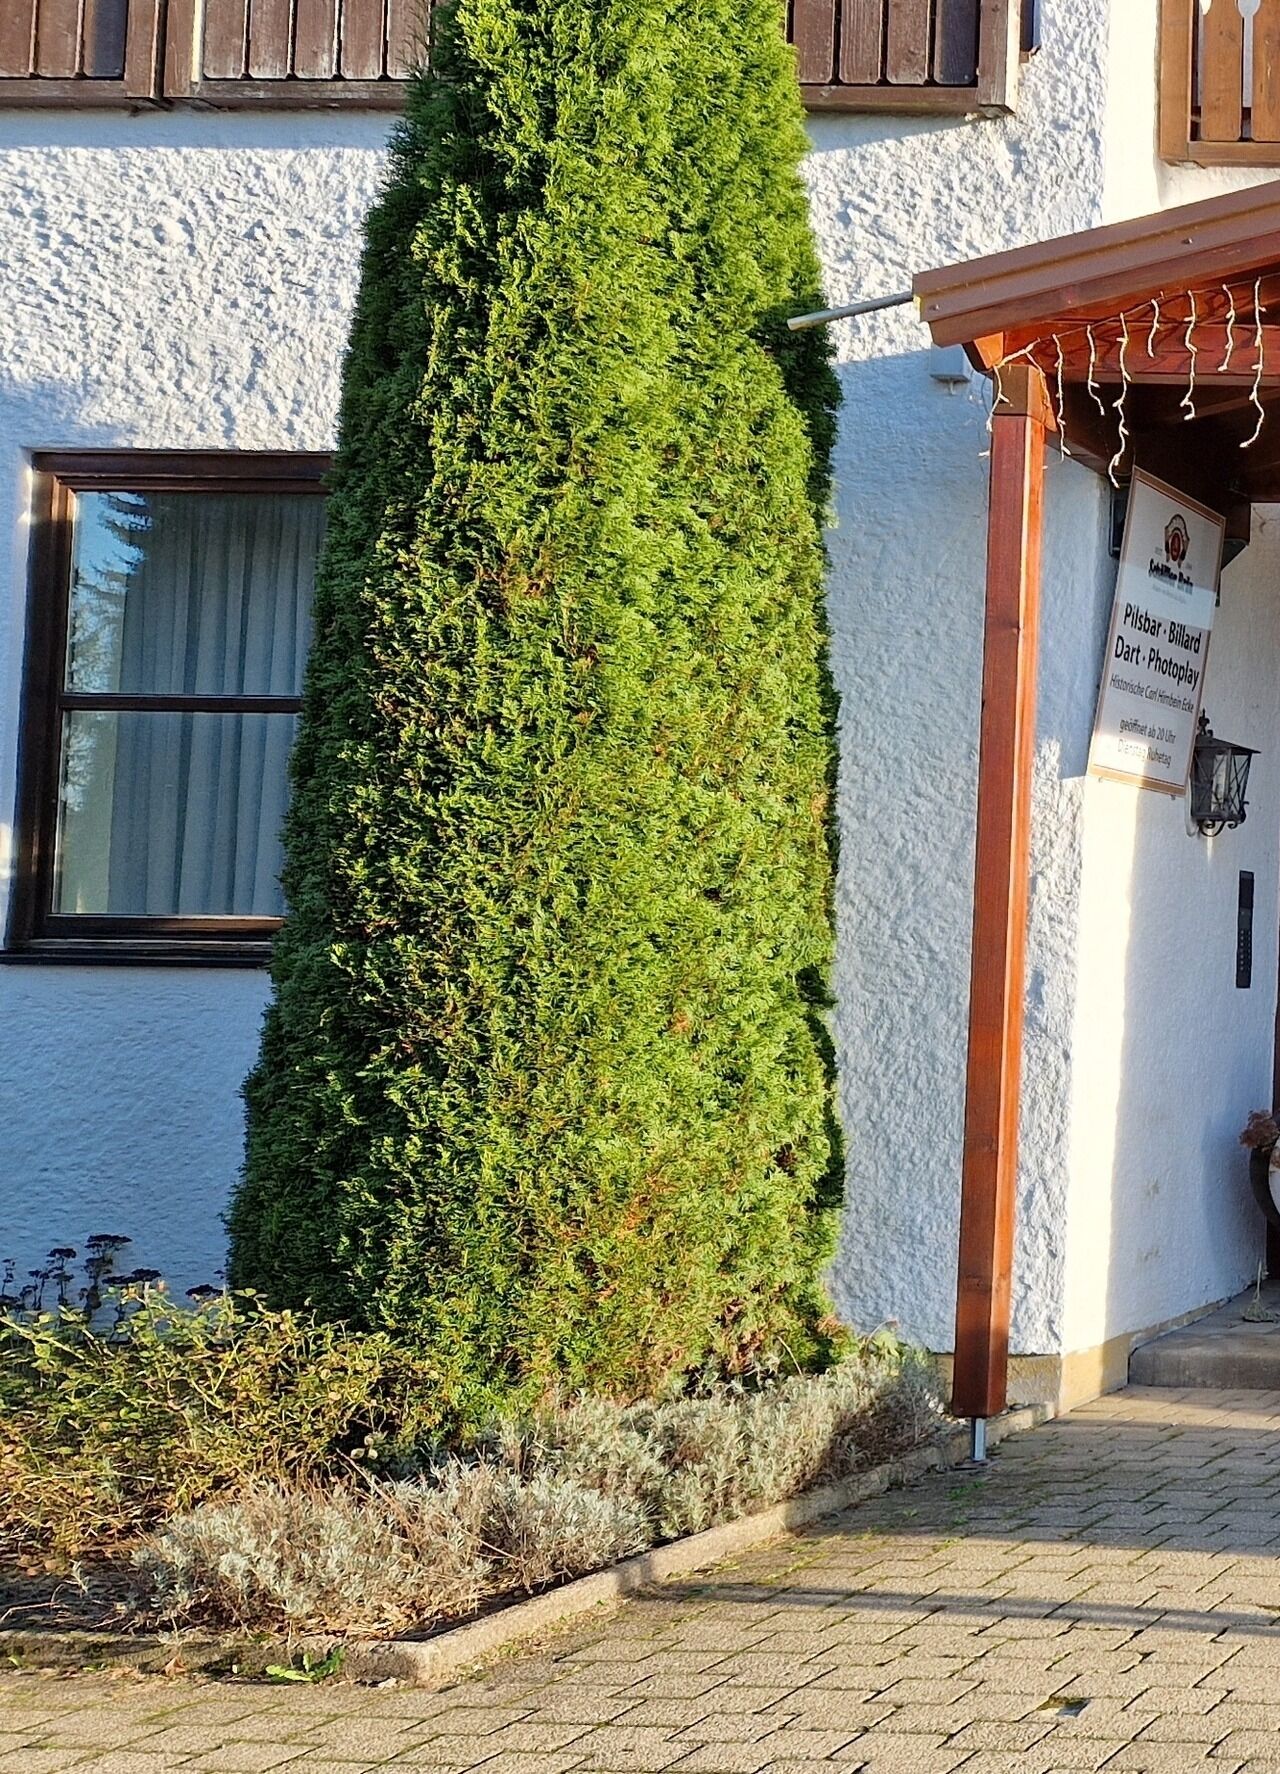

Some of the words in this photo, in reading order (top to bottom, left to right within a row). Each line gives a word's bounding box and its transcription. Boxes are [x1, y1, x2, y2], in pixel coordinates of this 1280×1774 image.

[1123, 602, 1162, 638] Pilsbar
[1168, 620, 1202, 655] Billard
[1114, 634, 1141, 666] Dart
[1147, 647, 1200, 693] Photoplay
[1109, 672, 1145, 697] Historische
[1144, 684, 1158, 703] Carl
[1181, 697, 1194, 714] Ecke
[1119, 717, 1148, 738] geöffnet
[1147, 724, 1156, 739] ab
[1156, 727, 1165, 742] 20
[1165, 730, 1176, 745] Uhr
